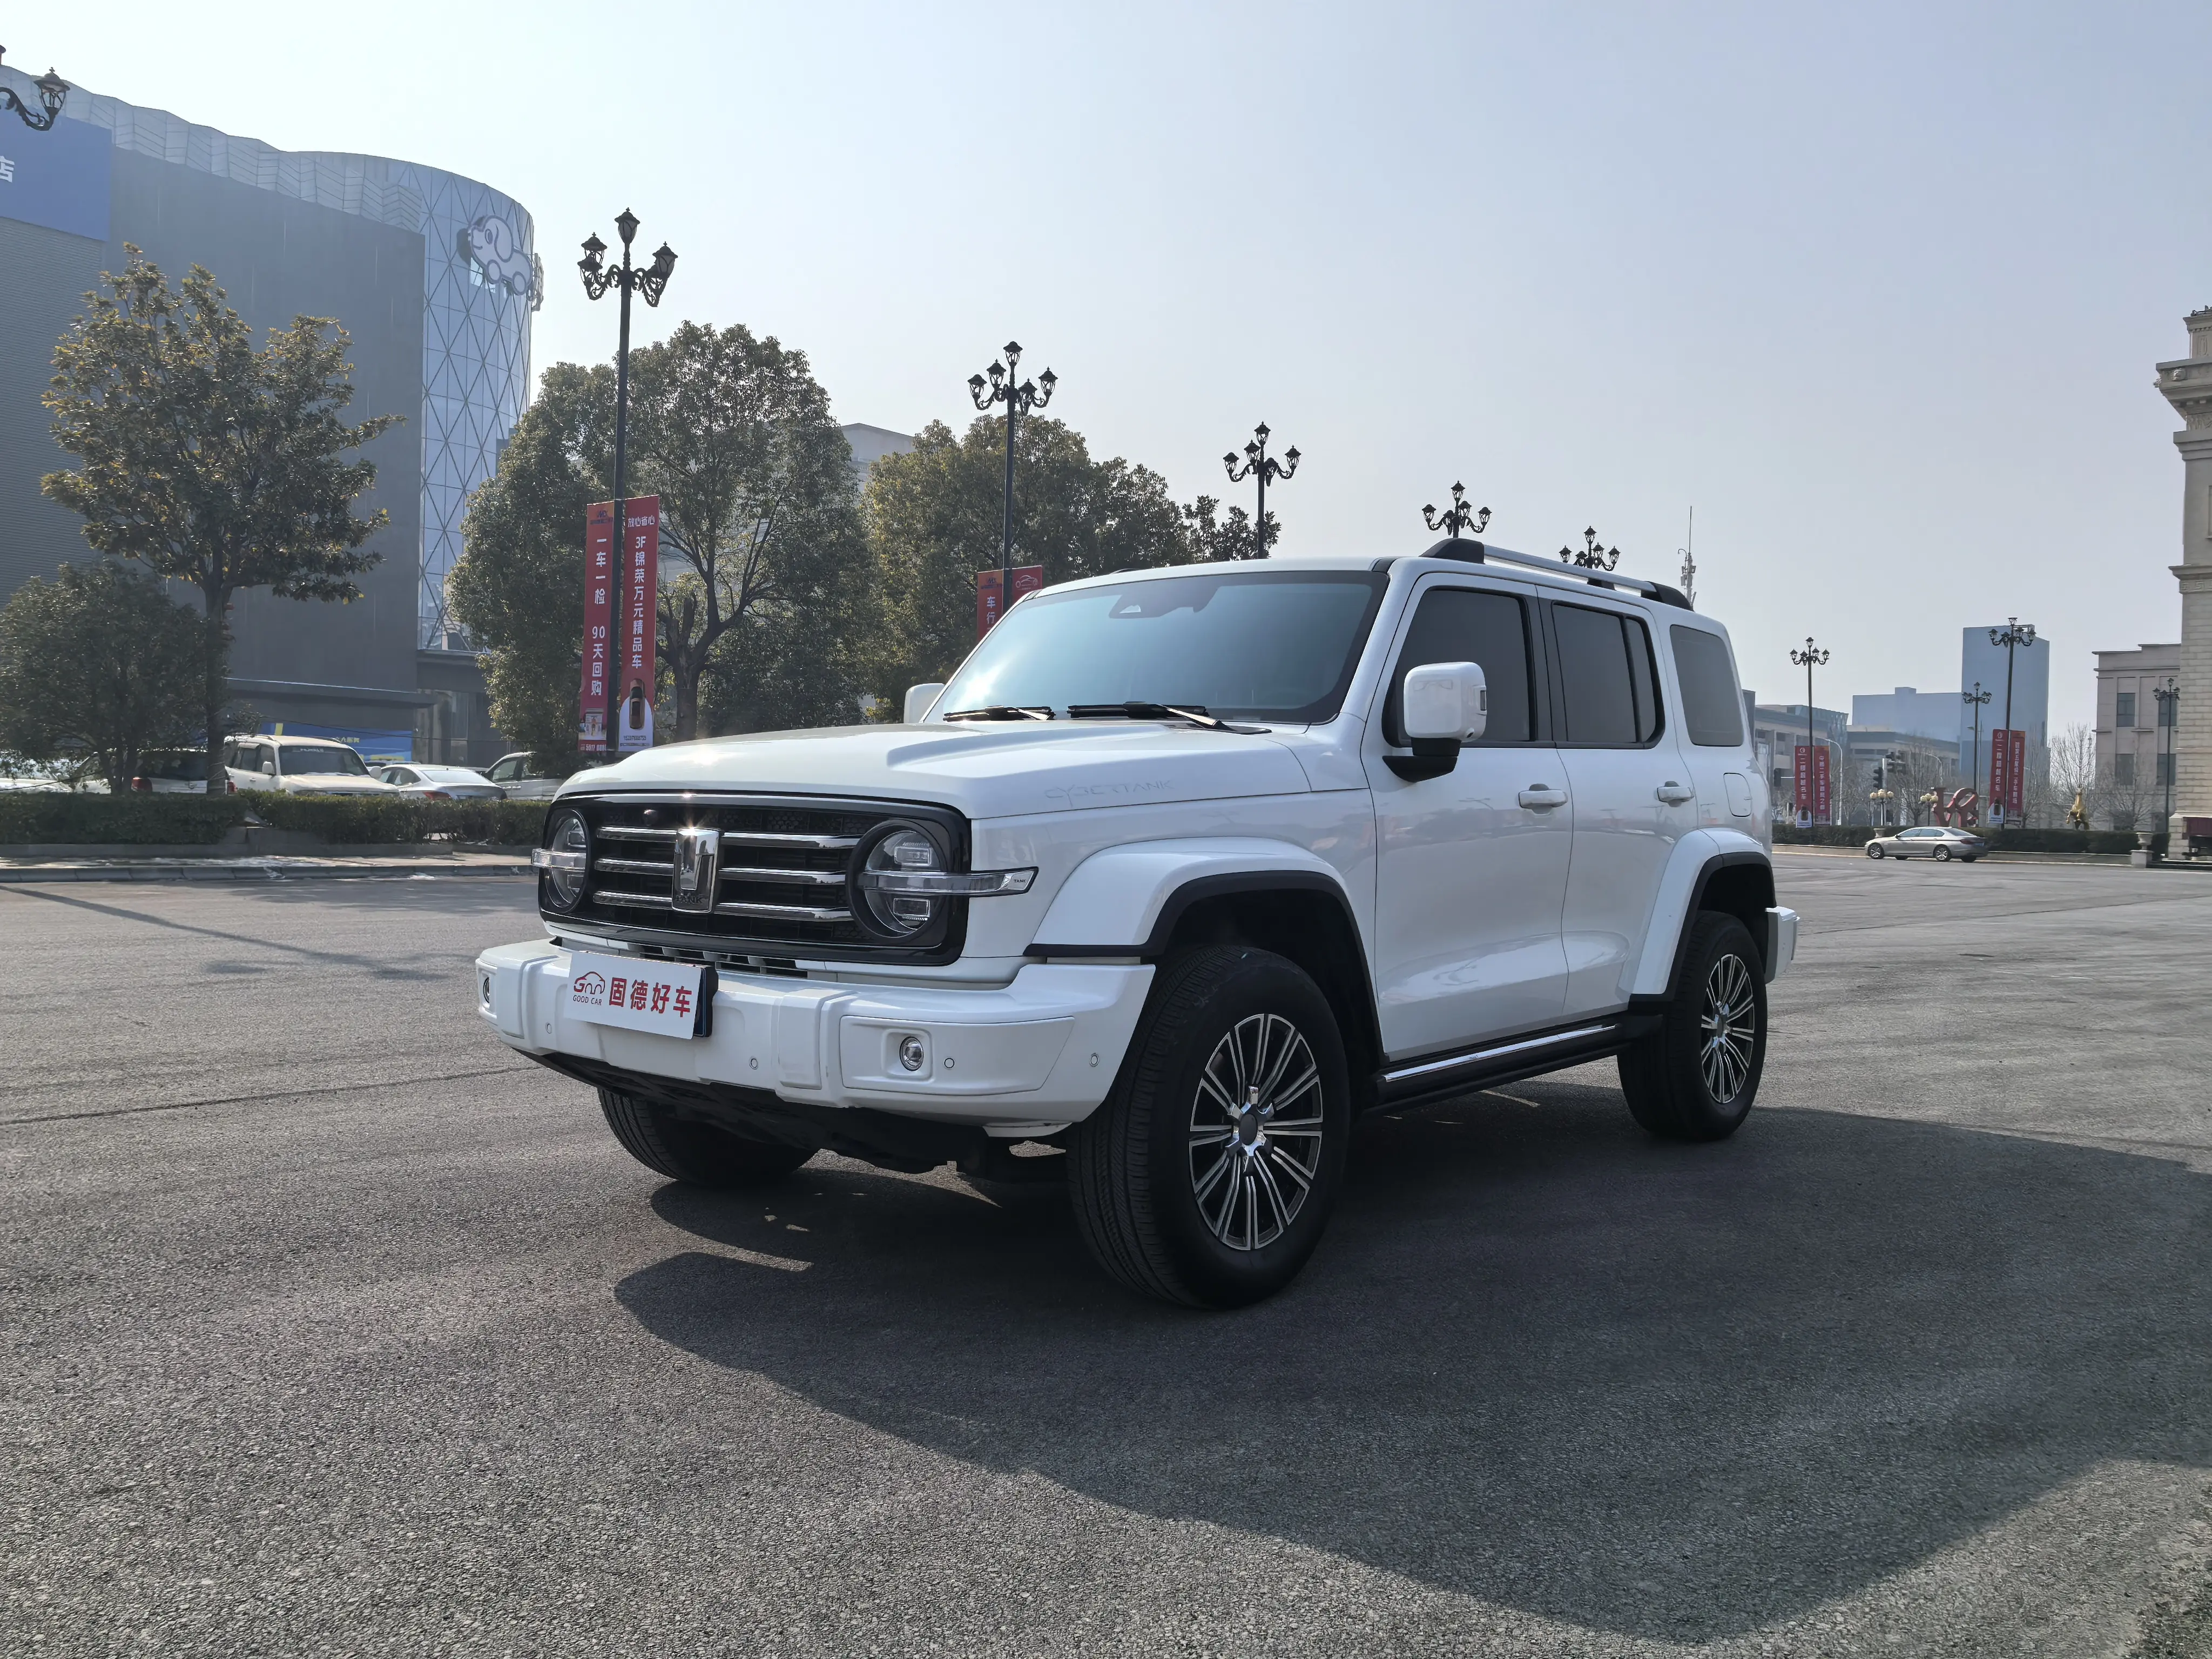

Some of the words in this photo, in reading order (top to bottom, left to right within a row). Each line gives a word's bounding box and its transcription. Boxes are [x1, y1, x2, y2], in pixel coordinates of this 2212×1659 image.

[628, 515, 655, 527] 放心省心
[595, 538, 606, 604] 一车一检
[987, 596, 995, 630] 车行
[591, 625, 605, 696] 90天回购
[675, 895, 703, 905] TANK
[573, 995, 589, 1003] GOOD
[591, 997, 602, 1006] CAR
[609, 977, 692, 1017] 固德好车
